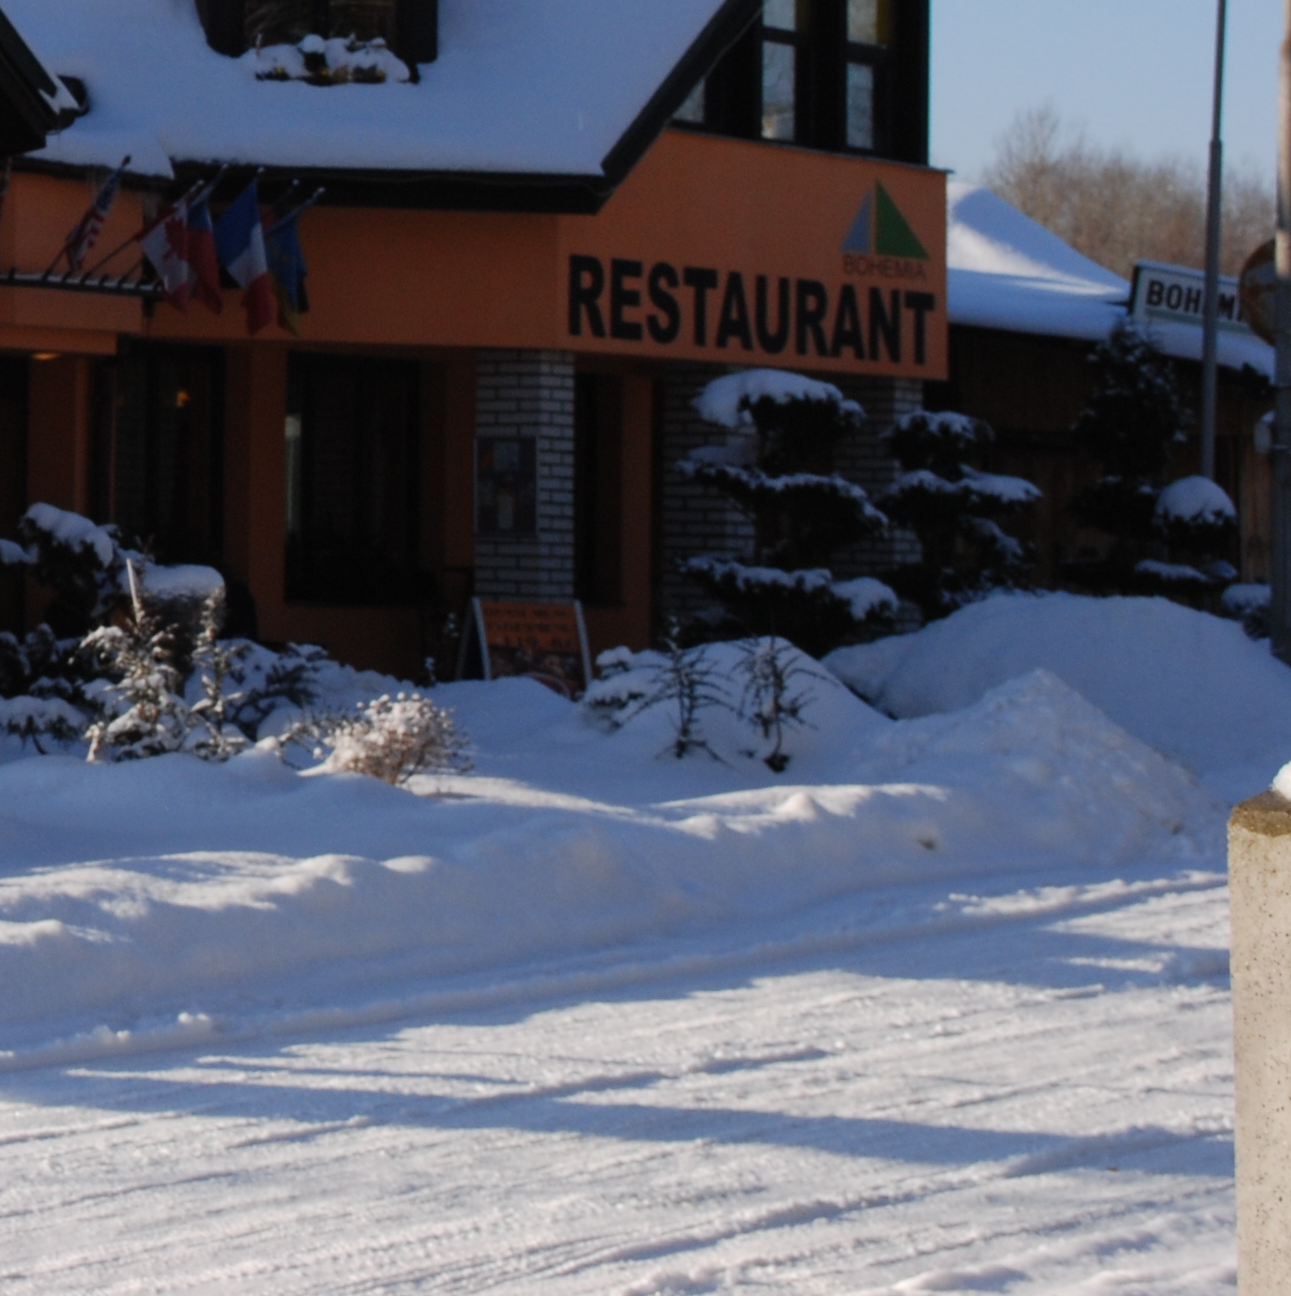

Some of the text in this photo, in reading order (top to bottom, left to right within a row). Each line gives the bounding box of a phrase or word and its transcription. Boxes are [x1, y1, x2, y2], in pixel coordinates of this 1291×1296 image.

[843, 254, 927, 281] BOHEMIA
[568, 253, 936, 365] RESTAURANT
[1146, 279, 1243, 322] BOHM
